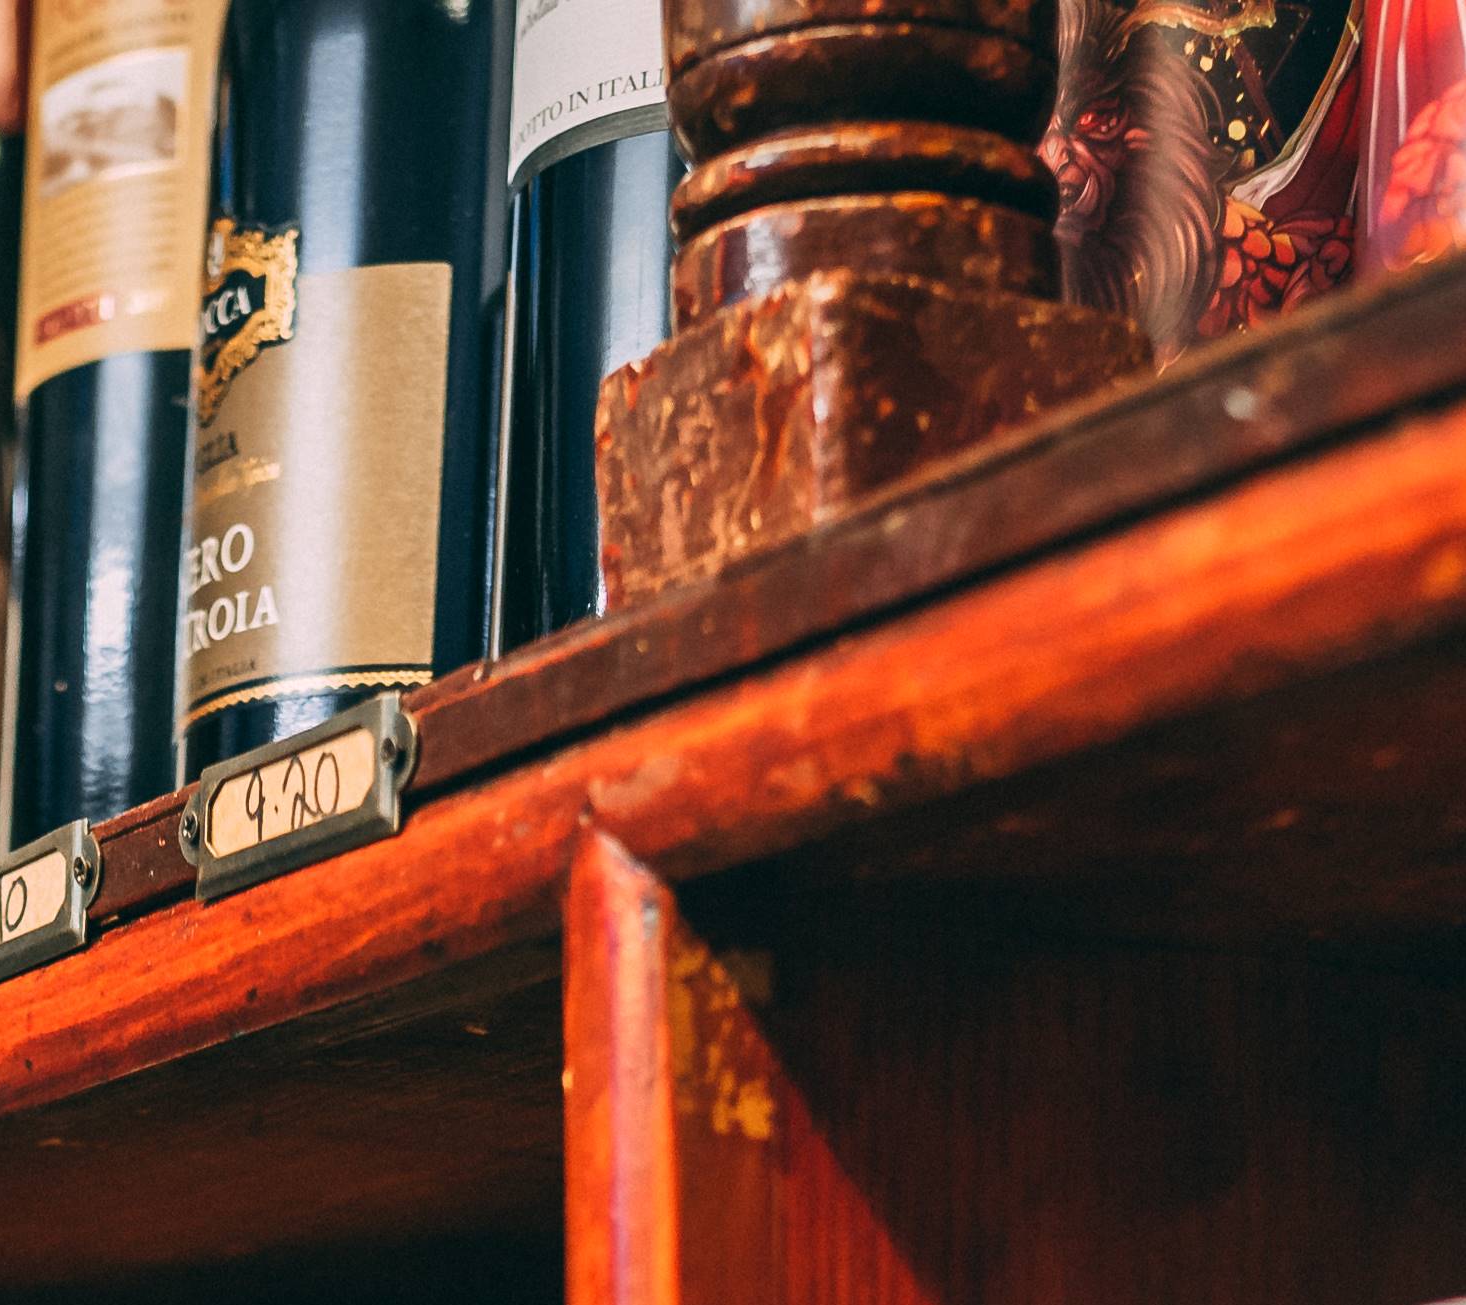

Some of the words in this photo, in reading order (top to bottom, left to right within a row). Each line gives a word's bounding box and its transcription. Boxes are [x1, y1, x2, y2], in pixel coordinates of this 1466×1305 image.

[514, 100, 563, 143] OTTO
[568, 86, 591, 113] IN
[596, 66, 665, 102] ITALI
[203, 285, 253, 335] CCA
[187, 522, 256, 598] ERO
[245, 751, 341, 842] 9.20
